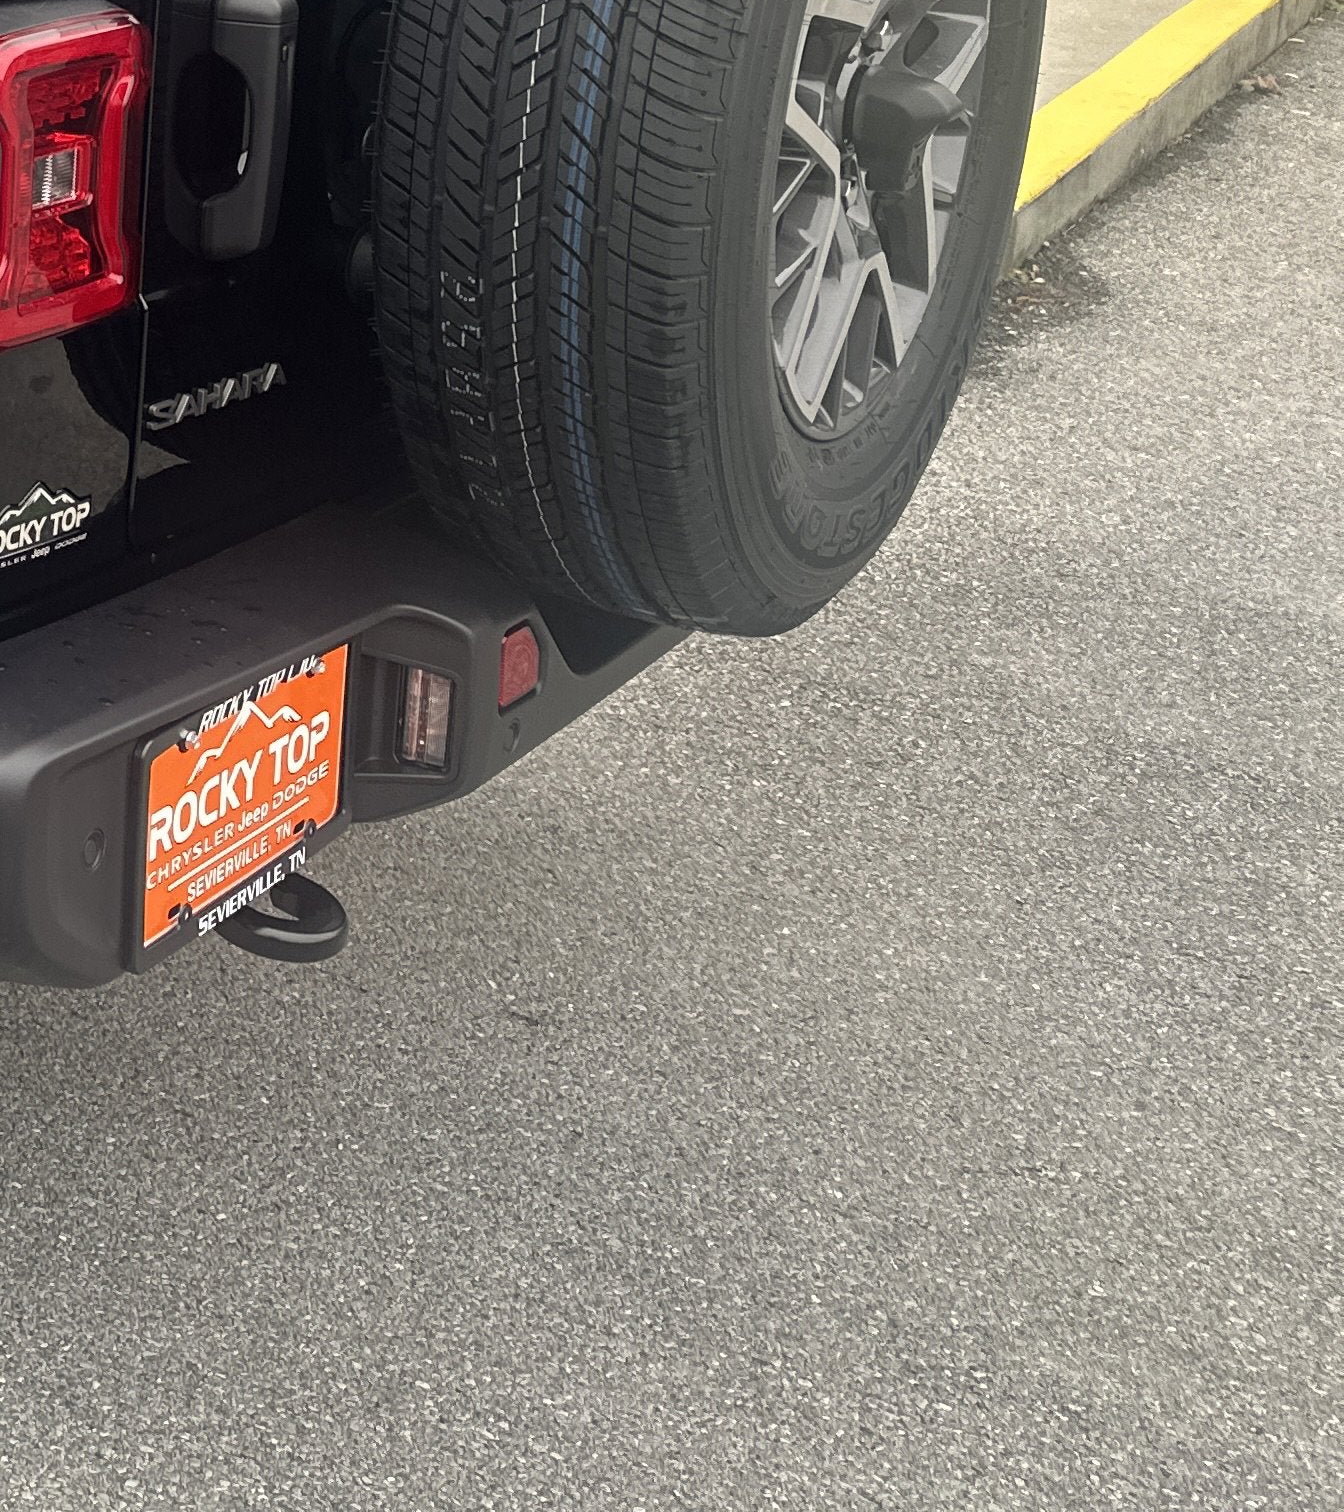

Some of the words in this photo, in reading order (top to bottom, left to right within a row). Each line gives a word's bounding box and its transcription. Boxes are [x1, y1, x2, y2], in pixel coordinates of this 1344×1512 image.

[146, 362, 288, 431] SAHARA
[50, 501, 91, 536] TOP
[197, 685, 255, 737] ROCKY
[255, 669, 286, 702] TOP
[147, 822, 235, 890] CHRYSLER
[237, 802, 269, 832] Jeep
[272, 759, 330, 811] DODGE
[148, 749, 263, 863] ROCKY
[268, 710, 330, 786] TOP
[187, 835, 272, 903] SEVIERVILLE,
[276, 820, 293, 845] TN
[198, 863, 286, 937] SEVIERVILLE,
[289, 846, 306, 873] TN
